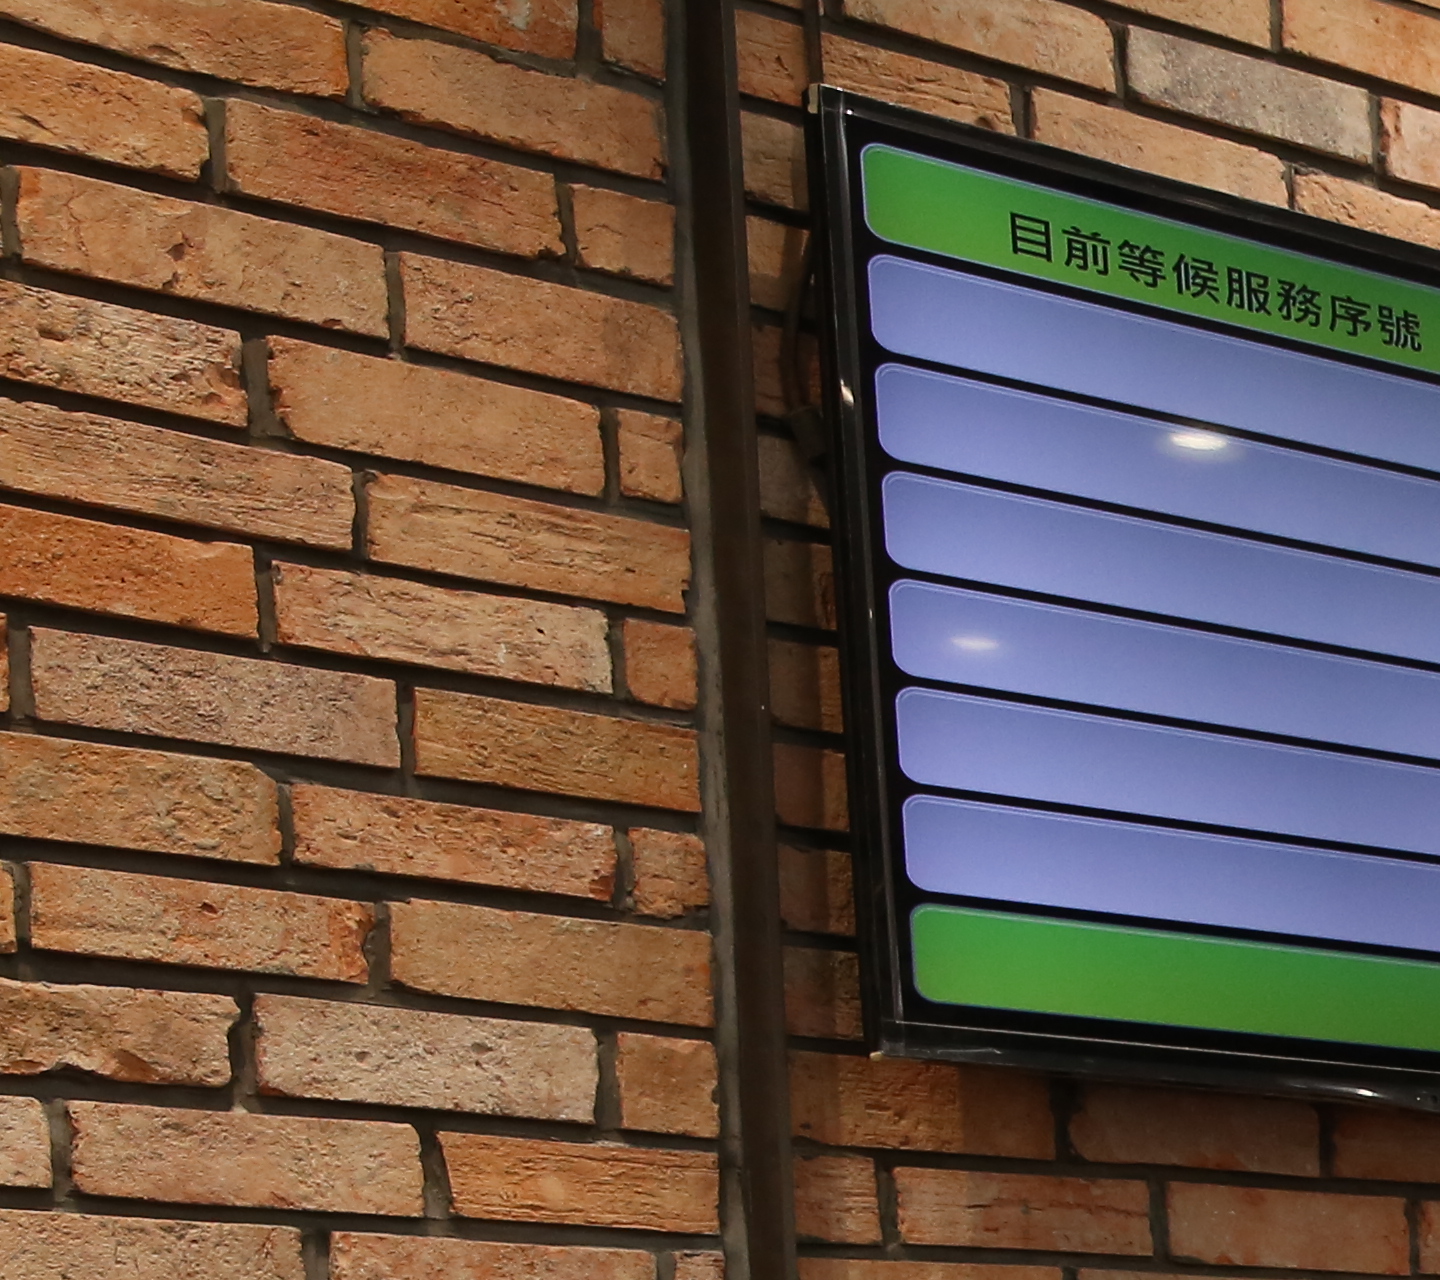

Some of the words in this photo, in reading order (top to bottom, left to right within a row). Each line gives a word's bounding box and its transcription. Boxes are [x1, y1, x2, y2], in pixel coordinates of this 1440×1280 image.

[1008, 210, 1424, 354] 目前等候服務序號
